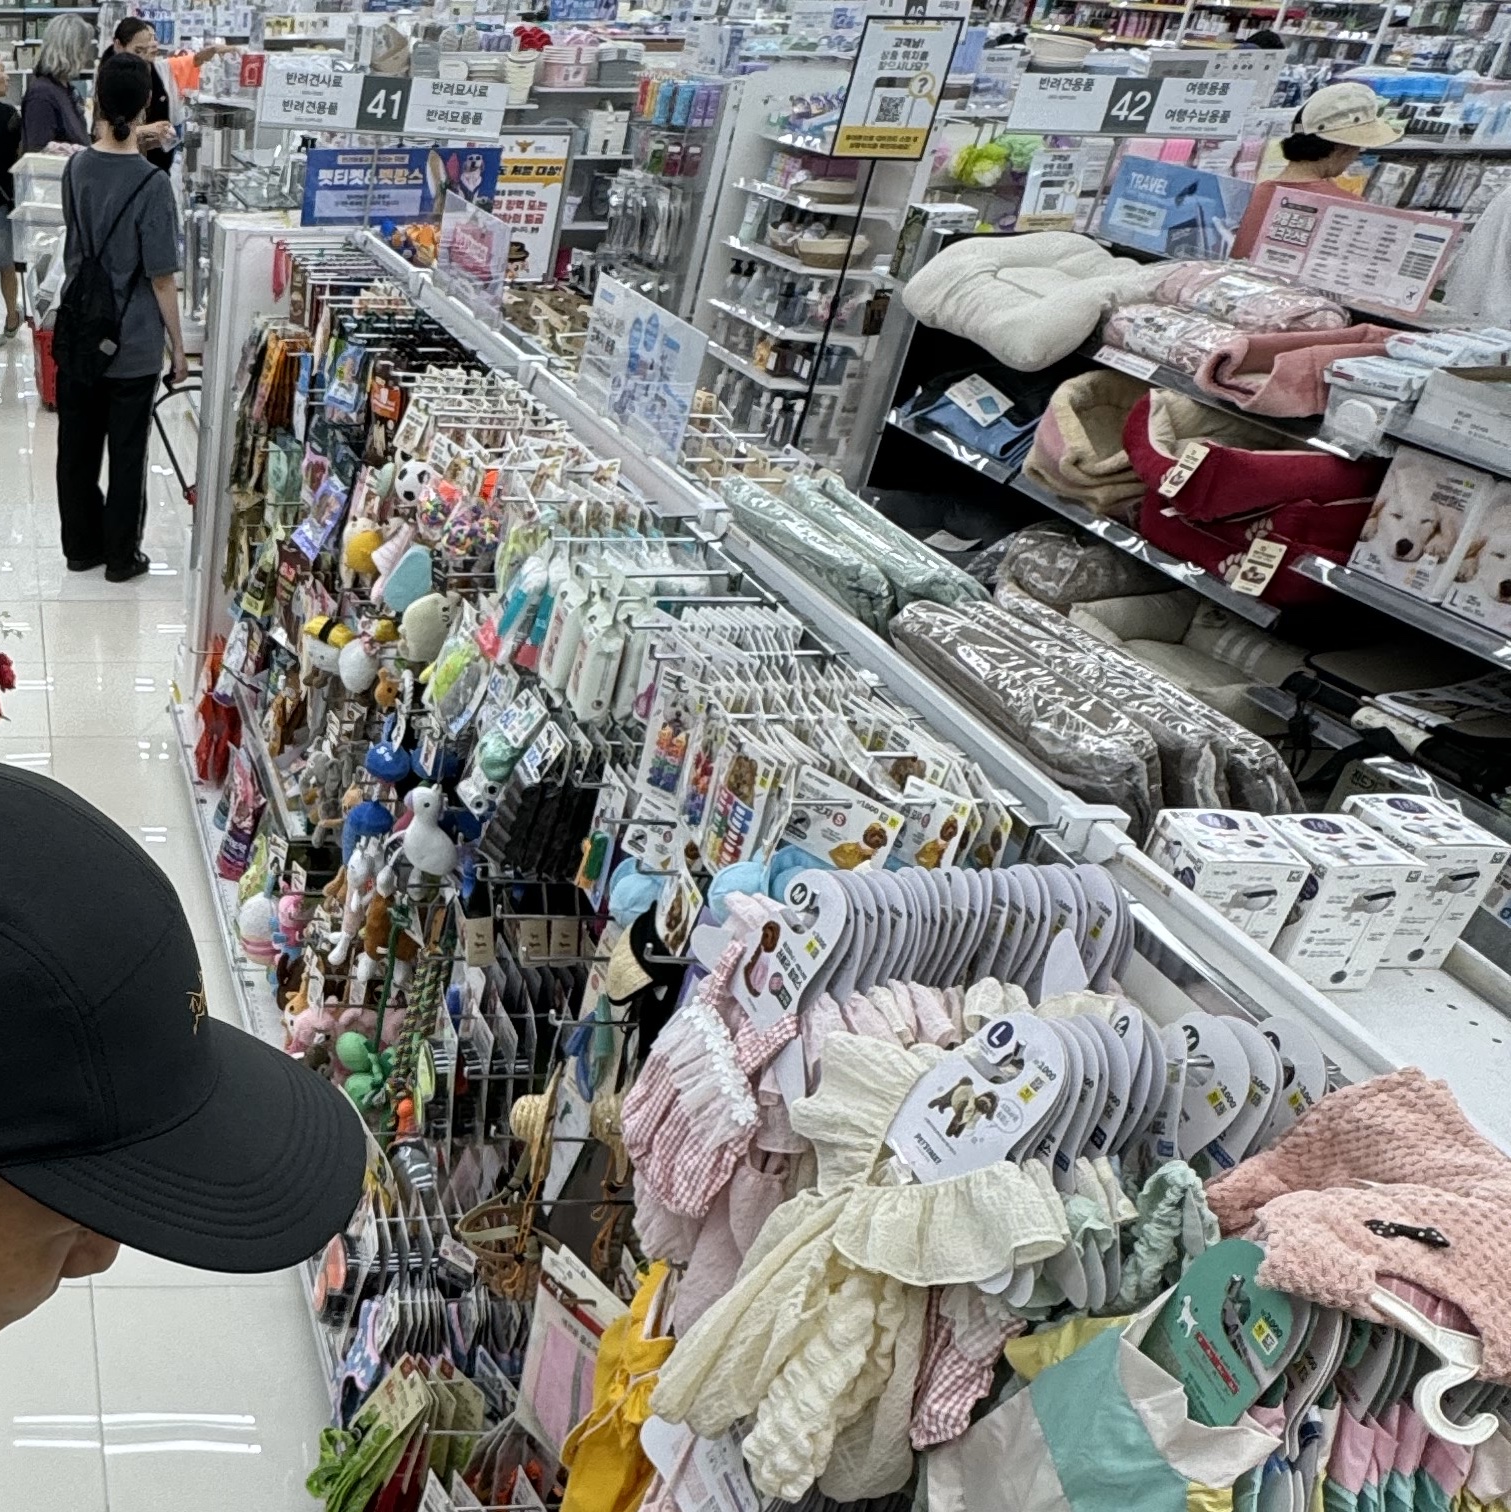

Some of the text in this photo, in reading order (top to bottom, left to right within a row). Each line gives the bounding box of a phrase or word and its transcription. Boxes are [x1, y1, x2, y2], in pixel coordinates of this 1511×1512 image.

[286, 71, 343, 88] 반려견사료
[1038, 77, 1095, 93] 반려견용품
[431, 81, 489, 98] 반려묘사료
[1185, 81, 1231, 96] 여행용품
[282, 99, 338, 116] 반려견용품
[366, 89, 403, 120] 41
[1110, 91, 1152, 122] 42
[426, 109, 483, 126] 반려묘용품
[1165, 108, 1231, 124] 여행수납용품
[1128, 172, 1169, 195] TRAVEL
[792, 886, 806, 903] M
[991, 1024, 1008, 1048] L
